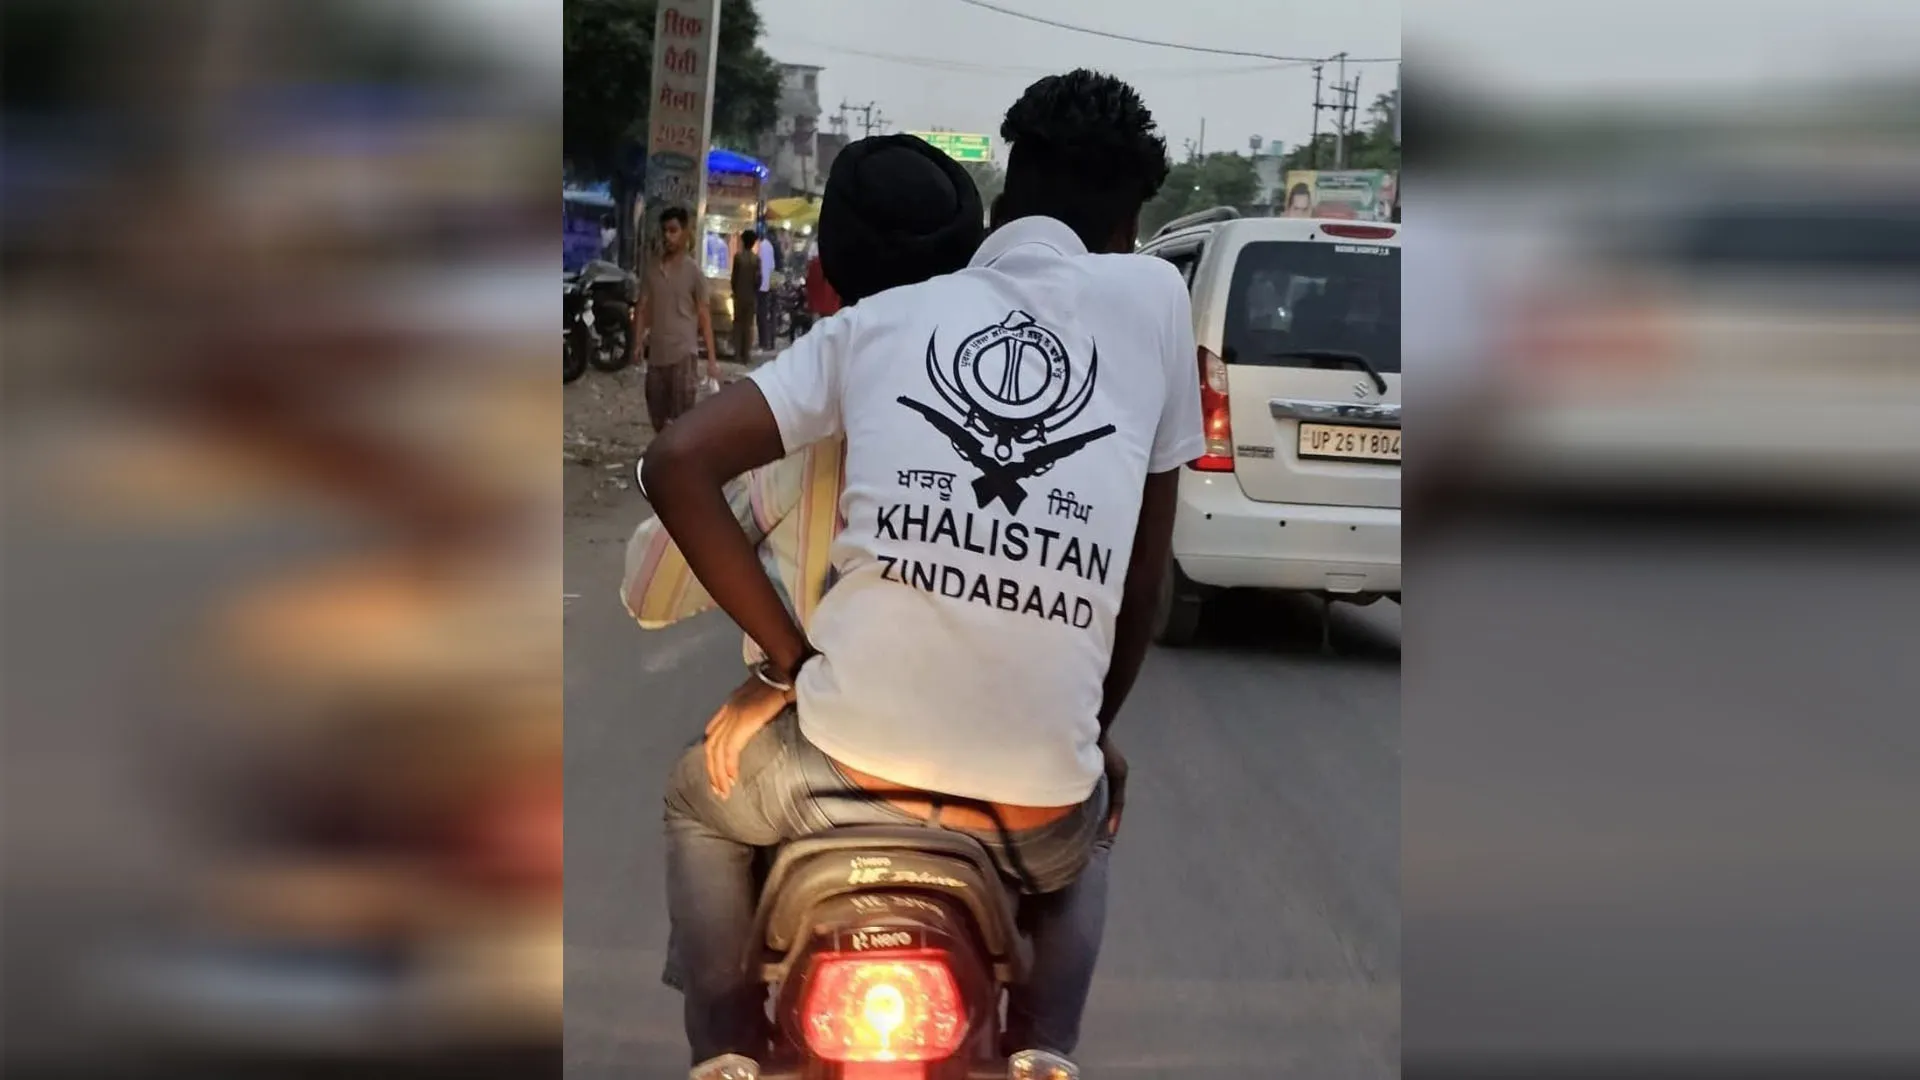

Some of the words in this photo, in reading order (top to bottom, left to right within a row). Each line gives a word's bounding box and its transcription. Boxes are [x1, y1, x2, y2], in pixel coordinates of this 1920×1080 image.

[656, 124, 696, 146] 2025
[1311, 431, 1331, 450] UP
[1358, 435, 1367, 452] Y
[897, 469, 957, 501] ਖਾੜਕੂ
[1047, 488, 1093, 525] ਸਿੰਘ
[874, 504, 1112, 585] KHALISTAN
[877, 554, 1093, 629] ZINDABAAD
